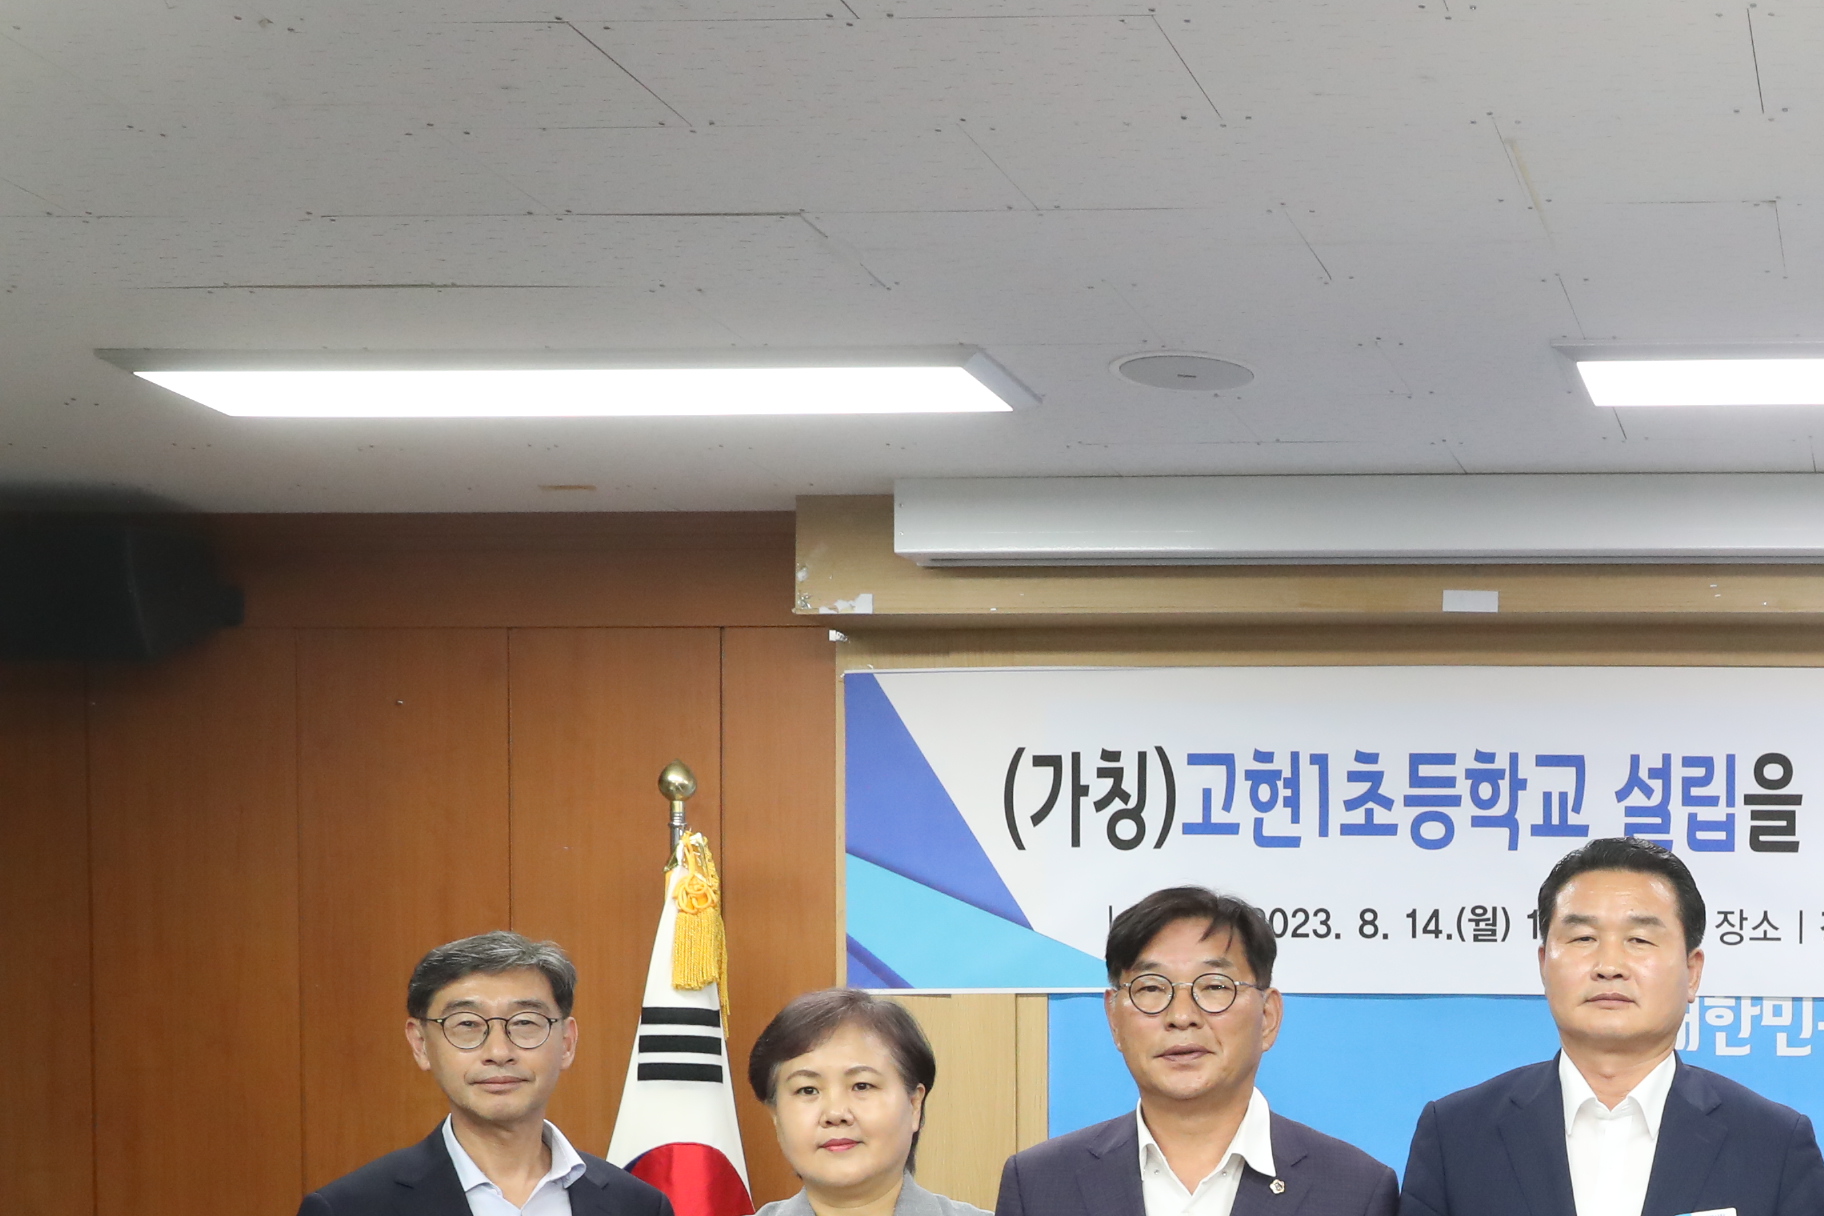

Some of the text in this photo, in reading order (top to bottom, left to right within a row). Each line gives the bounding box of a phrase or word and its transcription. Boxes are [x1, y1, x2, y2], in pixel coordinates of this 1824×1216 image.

[1003, 746, 1590, 851] (가칭)고현1초등학교
[1614, 752, 1804, 854] 설립을
[1258, 906, 1341, 940] 023.
[1714, 909, 1783, 946] 장소
